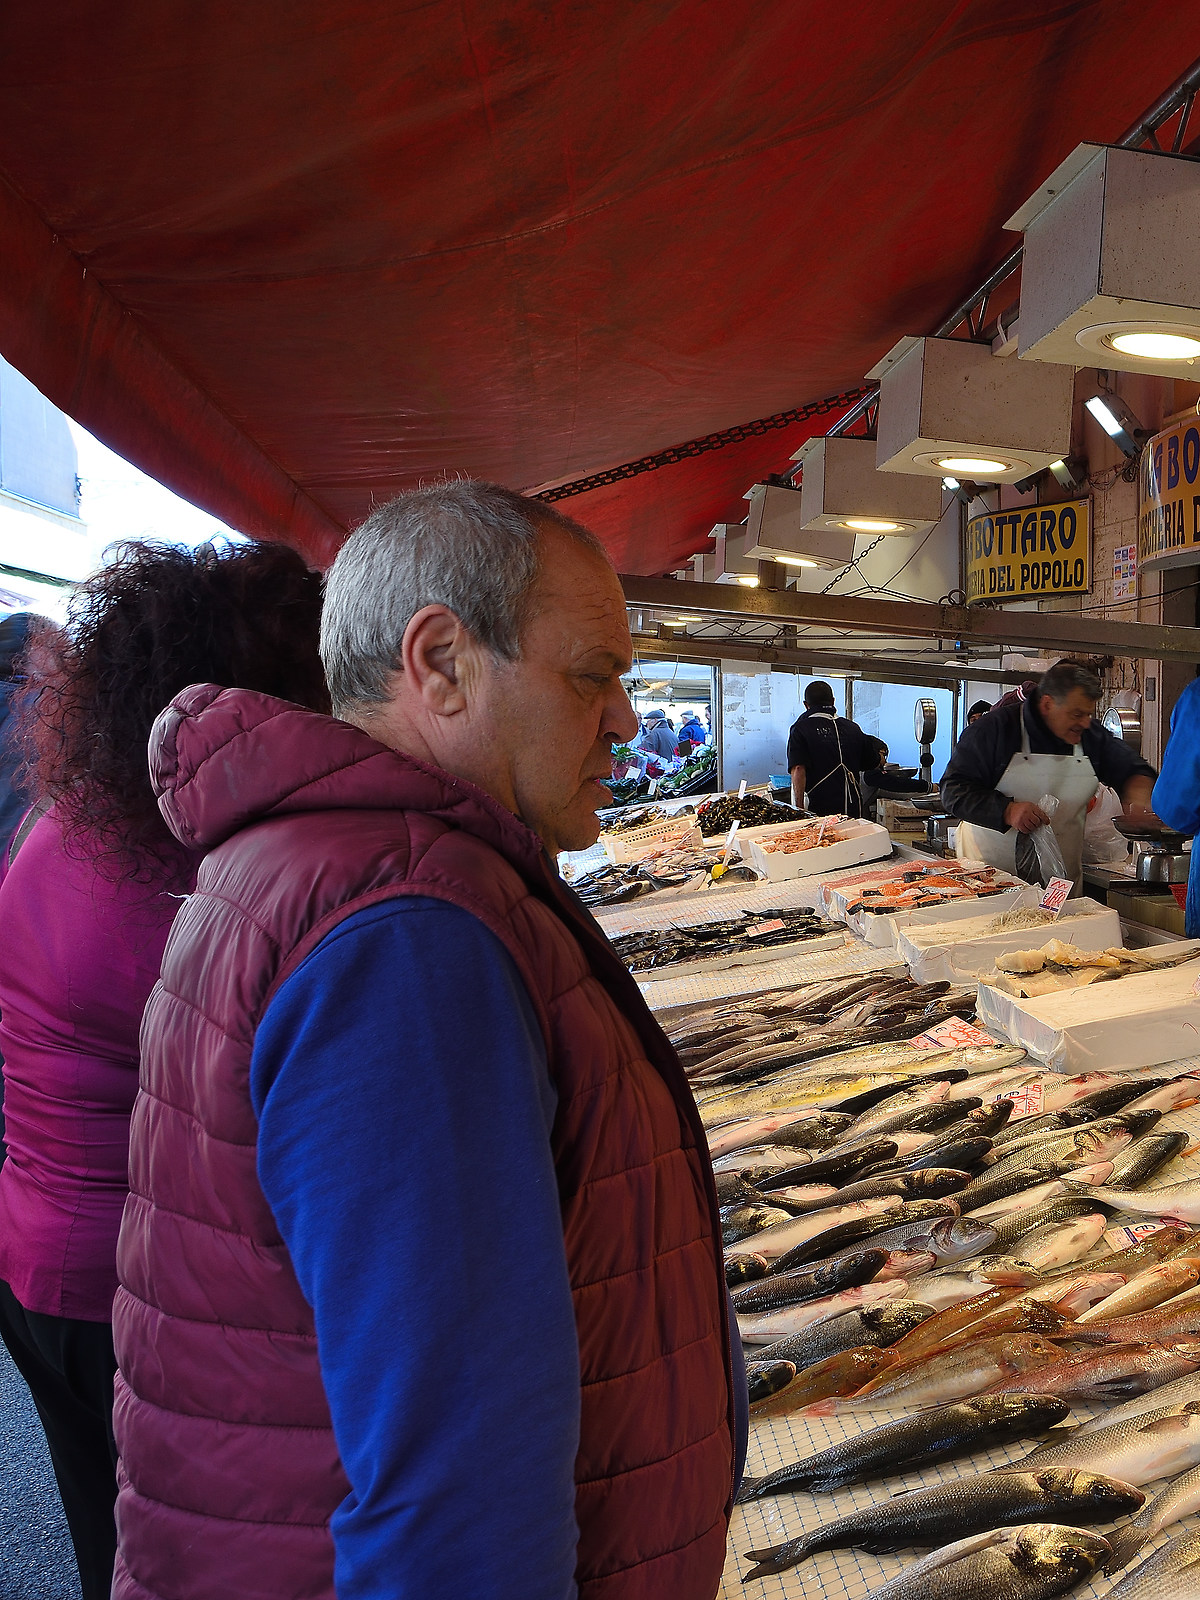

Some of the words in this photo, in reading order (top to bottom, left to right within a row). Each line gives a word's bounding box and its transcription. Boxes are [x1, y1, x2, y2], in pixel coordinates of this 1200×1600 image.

[975, 506, 1077, 563] BOTTARO
[989, 565, 1015, 593] DEL
[1020, 558, 1084, 591] POPOLO
